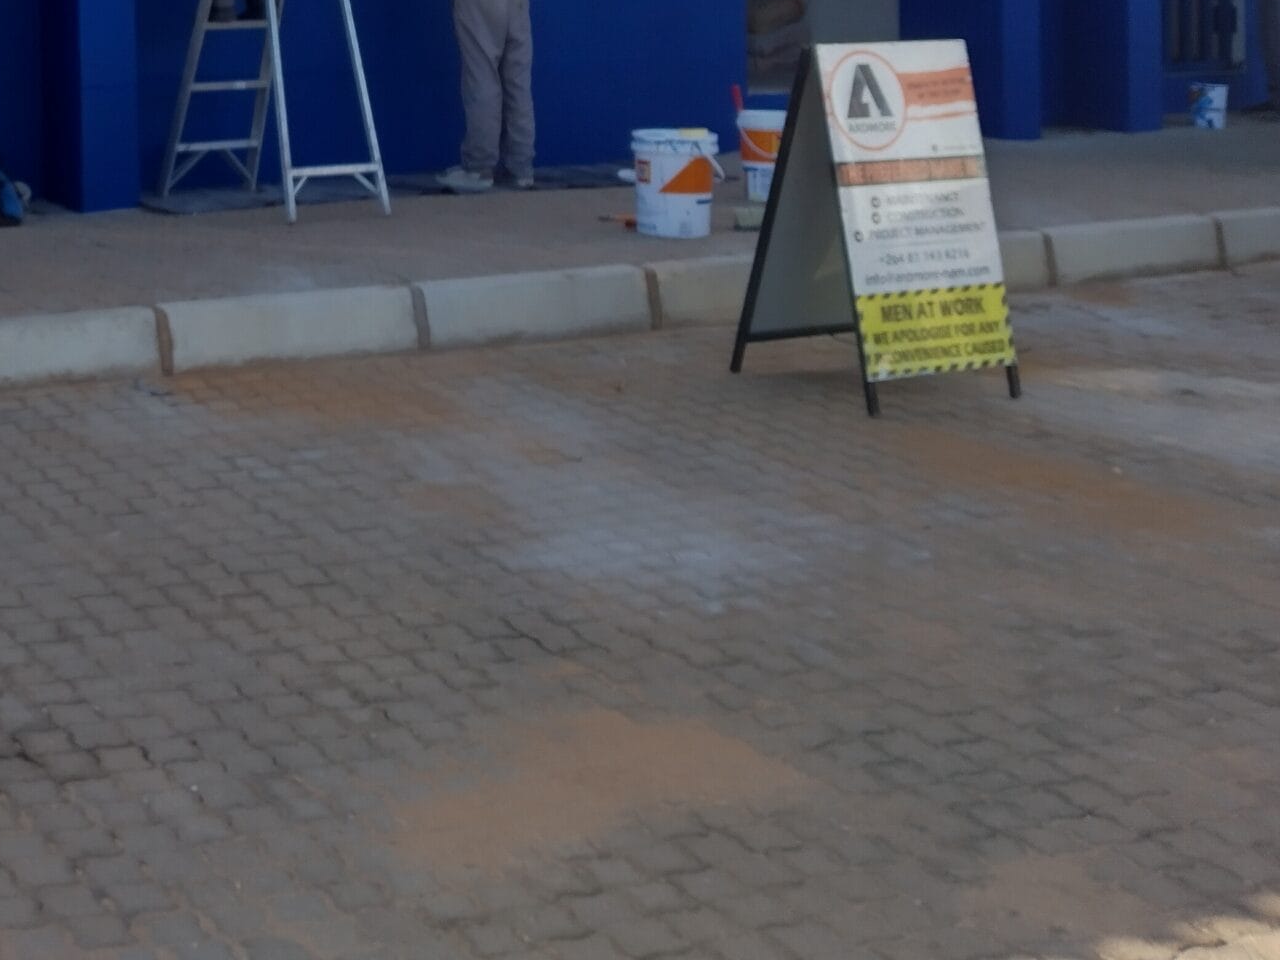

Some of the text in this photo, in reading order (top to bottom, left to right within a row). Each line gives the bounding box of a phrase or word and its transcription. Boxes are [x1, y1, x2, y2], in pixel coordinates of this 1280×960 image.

[886, 208, 964, 223] CONSTRUCTION
[870, 222, 985, 240] PROJECT MANAGEMENT
[881, 297, 986, 323] MEN AT WORK
[873, 331, 889, 345] WE
[954, 322, 975, 337] FOR
[979, 321, 1000, 334] ANY
[964, 338, 1005, 356] CAUSED
